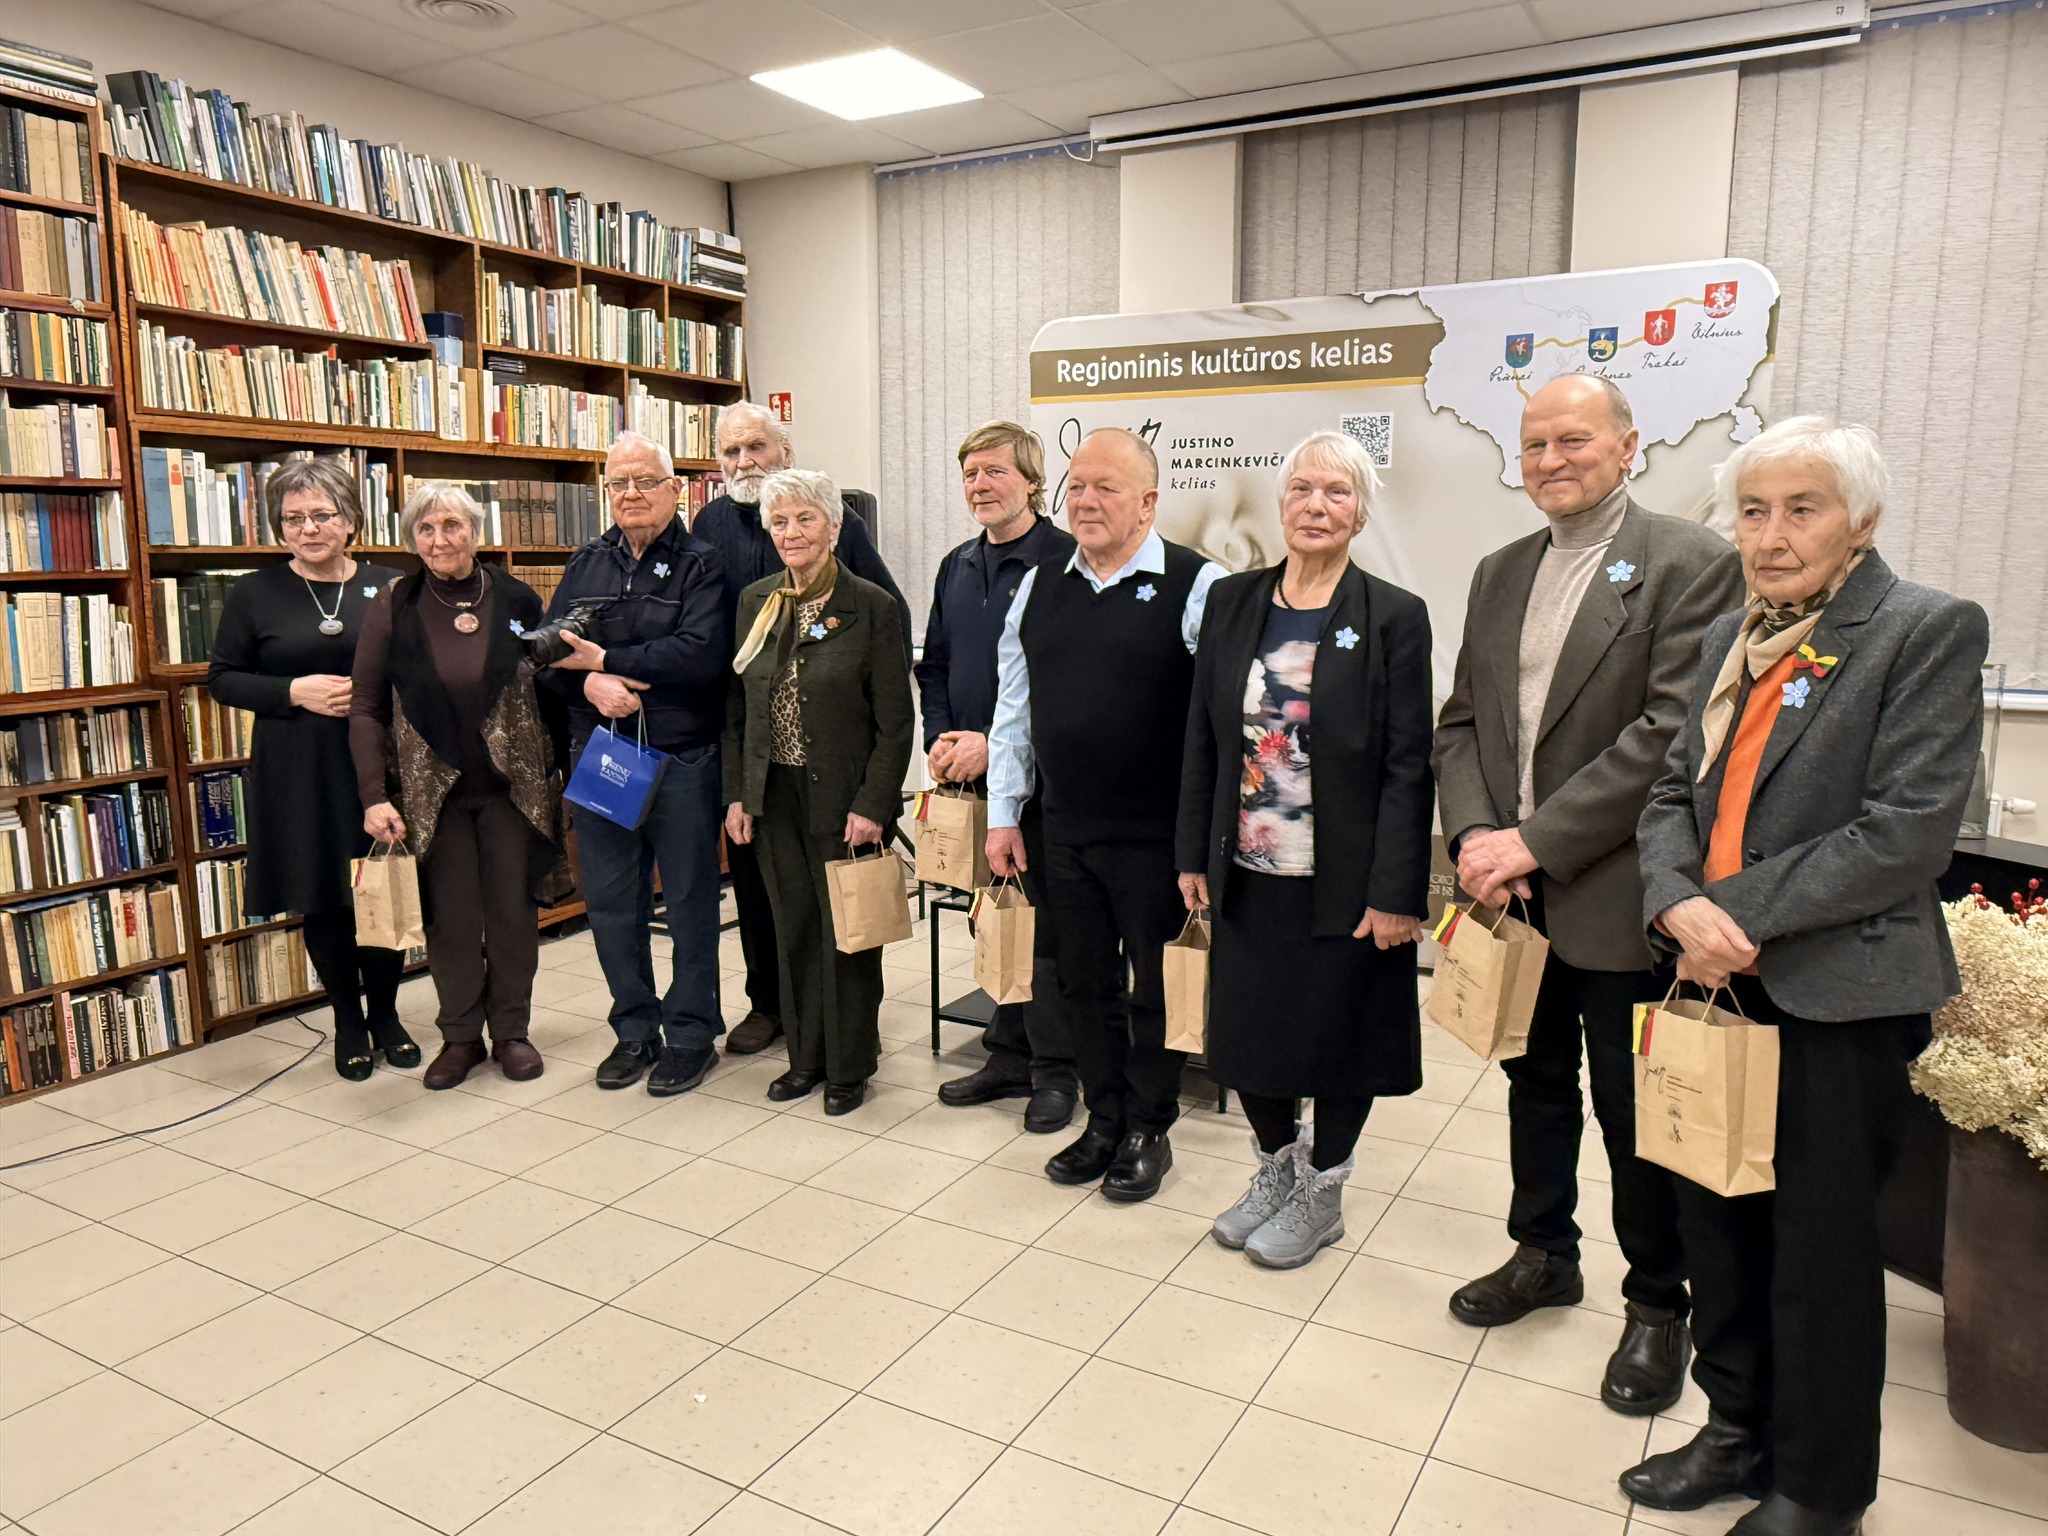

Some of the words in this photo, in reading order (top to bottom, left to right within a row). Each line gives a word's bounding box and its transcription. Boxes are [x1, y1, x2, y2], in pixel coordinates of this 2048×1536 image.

[1057, 351, 1183, 387] Regioninis
[1191, 346, 1302, 376] kultūros
[1310, 338, 1394, 368] kelias
[1171, 436, 1235, 449] JUSTINO
[1171, 452, 1286, 469] MARCINKEVIČI
[1170, 477, 1217, 489] kelias
